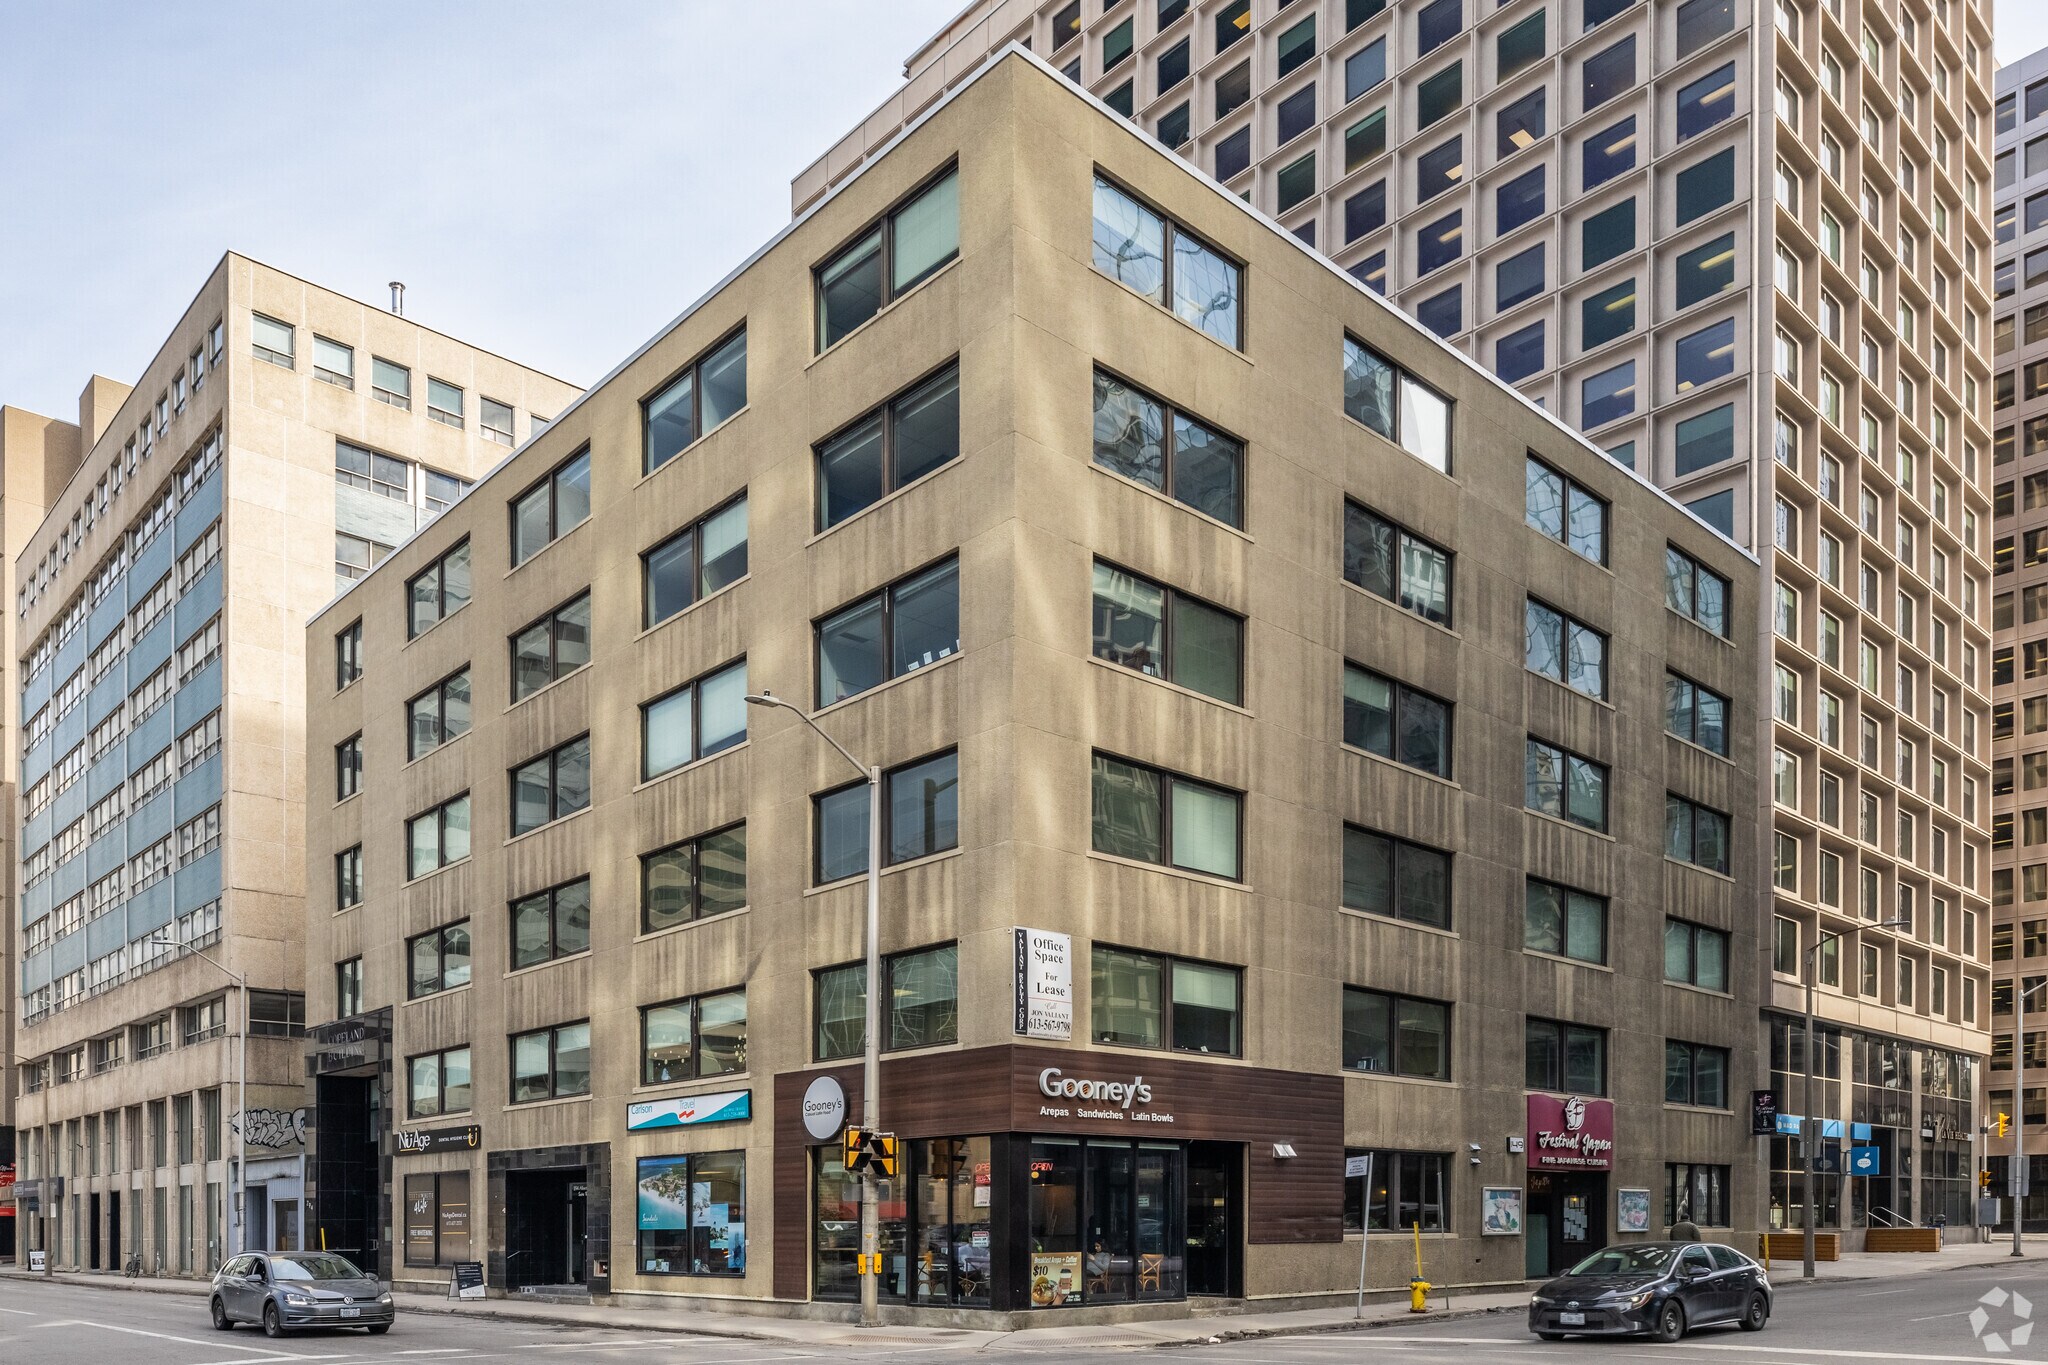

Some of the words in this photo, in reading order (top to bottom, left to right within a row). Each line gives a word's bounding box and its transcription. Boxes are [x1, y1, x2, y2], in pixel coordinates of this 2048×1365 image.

[1033, 937, 1064, 952] Office
[1035, 950, 1063, 964] Space
[1045, 972, 1058, 981] For
[1037, 982, 1065, 997] Lease
[1044, 1011, 1069, 1020] VALIANT
[1029, 1018, 1071, 1033] 613-567-9798
[328, 1027, 364, 1045] COPELAND
[328, 1044, 364, 1062] BUILDING
[1039, 1067, 1152, 1109] Gooney's
[631, 1104, 653, 1115] Carlson
[679, 1099, 696, 1110] Travel
[804, 1098, 842, 1112] Gooney's
[1040, 1106, 1069, 1117] Arepas
[1077, 1108, 1124, 1120] Sandwiches
[1131, 1112, 1150, 1121] Latin
[1151, 1113, 1174, 1123] Bowls
[1511, 1140, 1523, 1149] 149
[1538, 1131, 1579, 1150] Festival
[1582, 1133, 1611, 1156] Japan
[975, 1162, 990, 1172] OPE
[1031, 1162, 1053, 1171] OPEN
[1557, 1157, 1586, 1165] JAPANESE
[1587, 1158, 1608, 1166] CUISINE
[1033, 1265, 1048, 1277] $10
